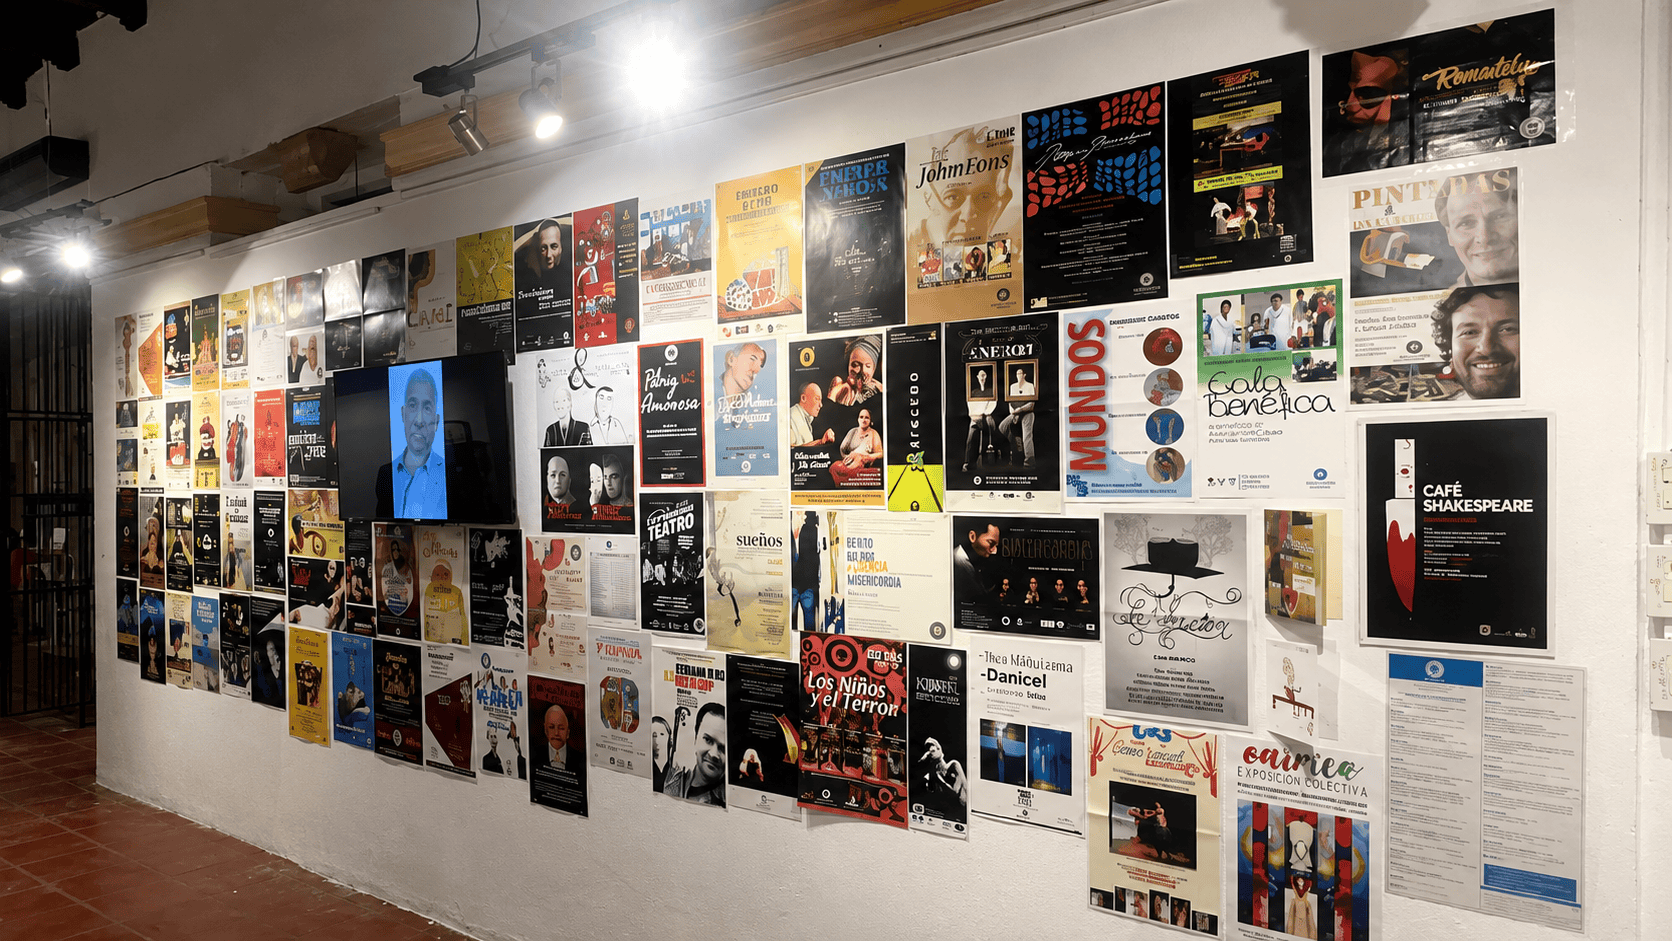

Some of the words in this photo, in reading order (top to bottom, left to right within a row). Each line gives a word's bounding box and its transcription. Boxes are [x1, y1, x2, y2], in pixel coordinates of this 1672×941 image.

[1067, 318, 1107, 471] MUNDOS
[1423, 481, 1463, 498] CAFÉ
[1423, 499, 1534, 513] SHAKESPEARE
[647, 513, 695, 542] TEATRO
[736, 532, 783, 548] sueños
[847, 574, 902, 588] MISERICORDIA
[808, 671, 835, 691] Los
[839, 676, 886, 699] Niños
[810, 691, 822, 708] y
[823, 691, 838, 708] el
[1304, 778, 1368, 798] COLECTIVA
